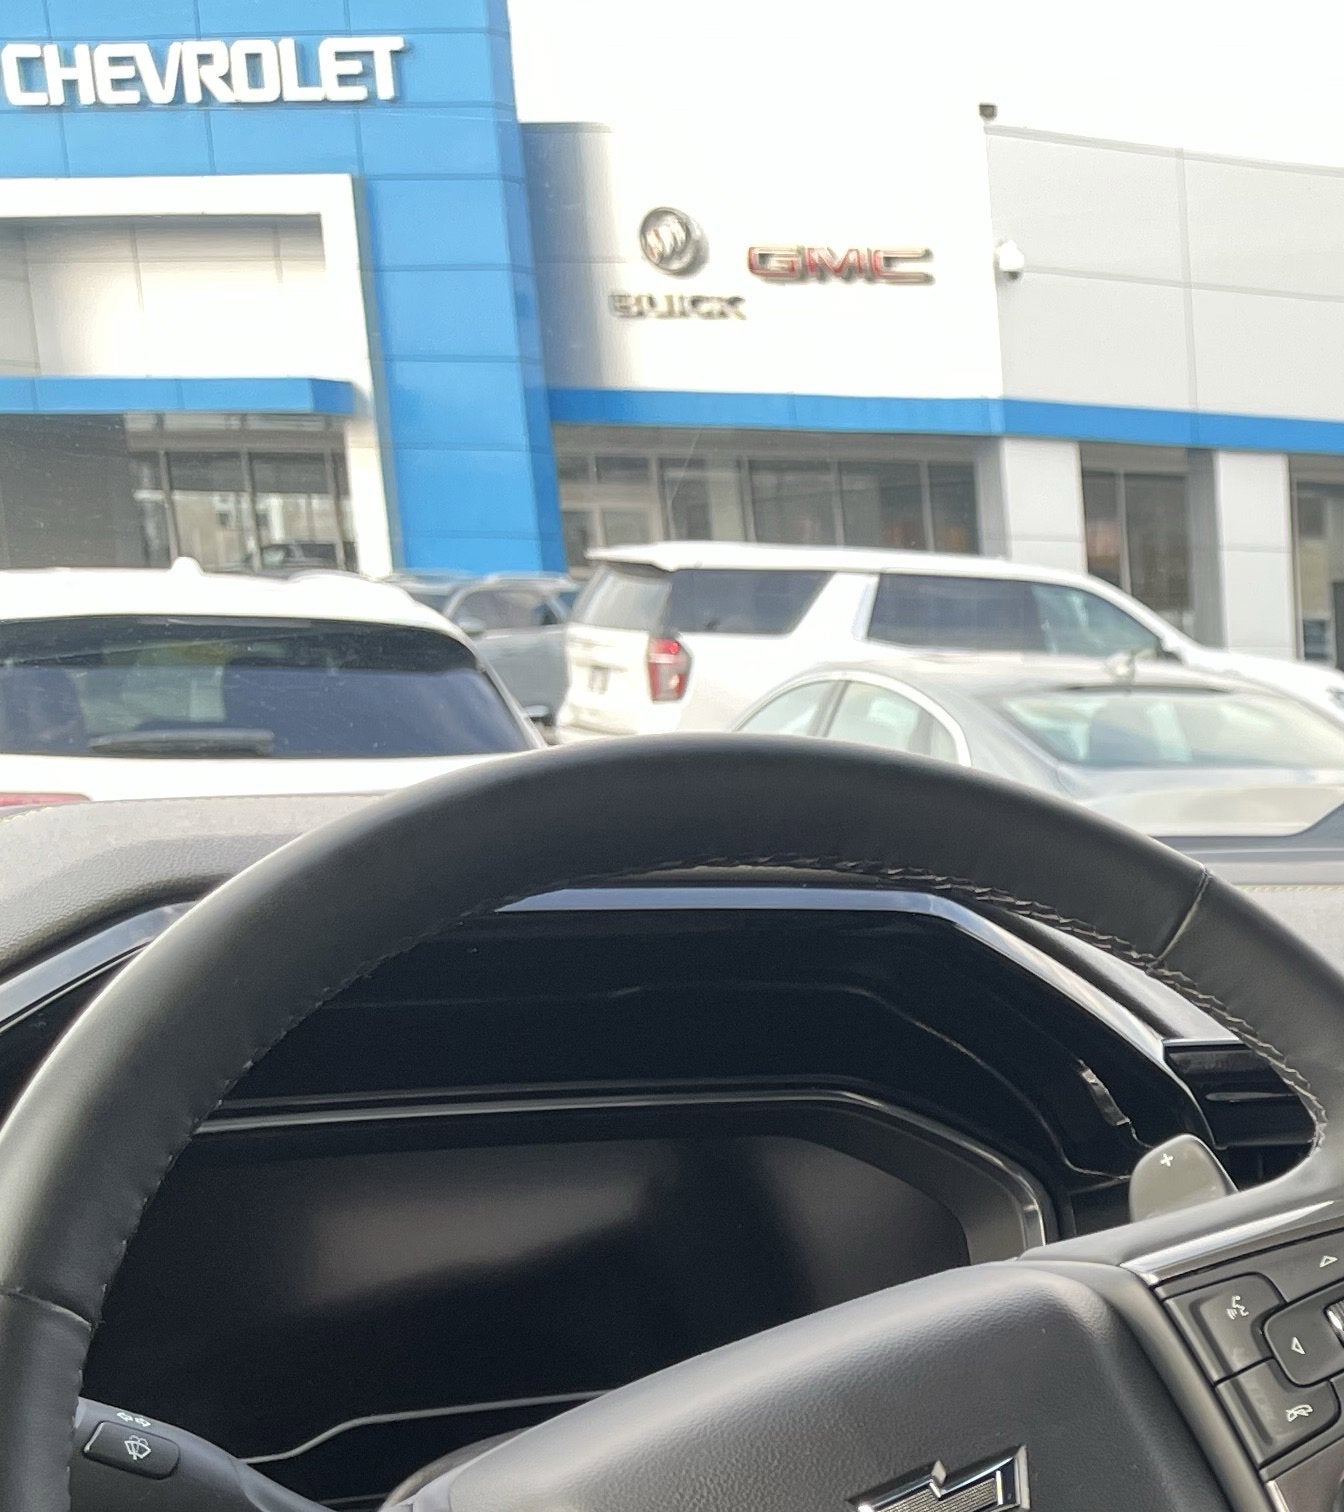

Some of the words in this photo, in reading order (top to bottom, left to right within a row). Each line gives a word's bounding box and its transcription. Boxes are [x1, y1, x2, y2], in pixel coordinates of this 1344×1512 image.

[1, 37, 404, 106] CHEVROLET
[747, 246, 933, 284] GMC
[609, 294, 747, 320] BUICK
